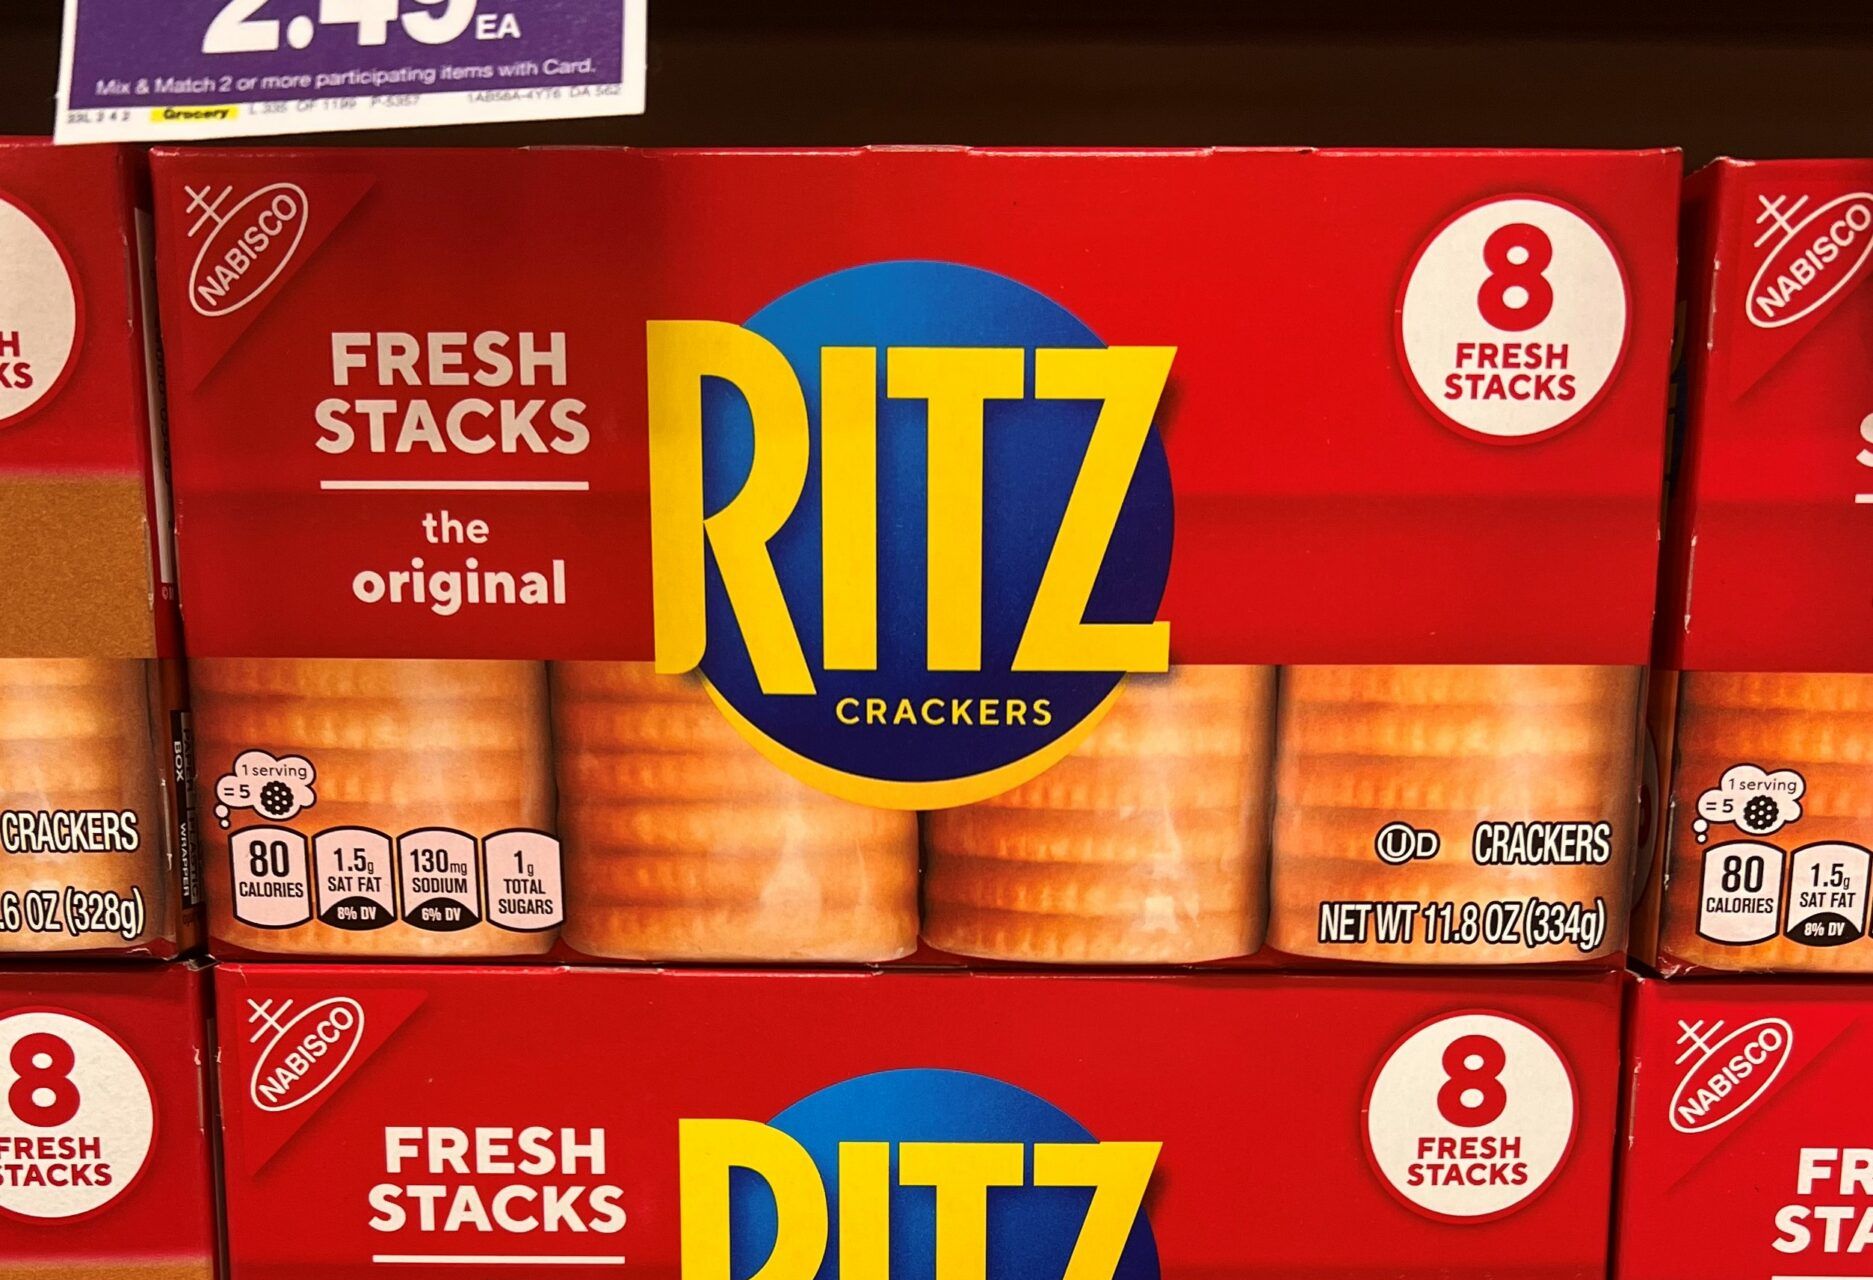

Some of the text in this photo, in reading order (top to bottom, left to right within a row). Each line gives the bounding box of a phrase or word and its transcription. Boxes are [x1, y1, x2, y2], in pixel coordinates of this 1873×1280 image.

[475, 13, 521, 40] EA
[95, 58, 596, 95] Mix Match or more participating items with Card.
[197, 195, 297, 306] NABISCO
[1756, 203, 1872, 318] NABISCO
[1477, 222, 1553, 332] 8
[330, 331, 568, 387] FRESH
[1456, 342, 1569, 369] FRESH
[1444, 374, 1576, 401] STACKS
[315, 398, 591, 454] STACKS
[646, 319, 1178, 695] RITZ
[422, 511, 490, 544] the
[352, 557, 567, 616] original
[836, 697, 1053, 726] CRACKERS
[252, 764, 308, 780] serving
[1739, 778, 1797, 794] serving
[2, 812, 139, 851] CRACKERS
[1475, 823, 1611, 863] CRACKERS
[250, 840, 290, 878] 80
[1721, 855, 1764, 893] 80
[239, 881, 304, 898] CALORIES
[328, 876, 382, 892] SAT FAT
[412, 878, 467, 893] SODIUM
[503, 879, 546, 895] TOTAL
[1799, 892, 1856, 908] SAT FAT
[25, 887, 144, 939] OZ (328g)
[337, 906, 377, 920] 8% DV
[421, 907, 461, 921] 6% DV
[498, 898, 553, 915] SUGARS
[1320, 899, 1605, 949] NET WT 11.8 OZ (334g)
[1706, 897, 1774, 914] CALORIES
[259, 1006, 354, 1103] NABISCO
[8, 1032, 80, 1128] 8
[1437, 1034, 1507, 1127] 8
[1679, 1027, 1783, 1124] NABISCO
[385, 1126, 605, 1175] FRESH
[1417, 1137, 1521, 1160] FRESH
[1407, 1163, 1528, 1186] STACKS
[369, 1185, 627, 1234] STACKS
